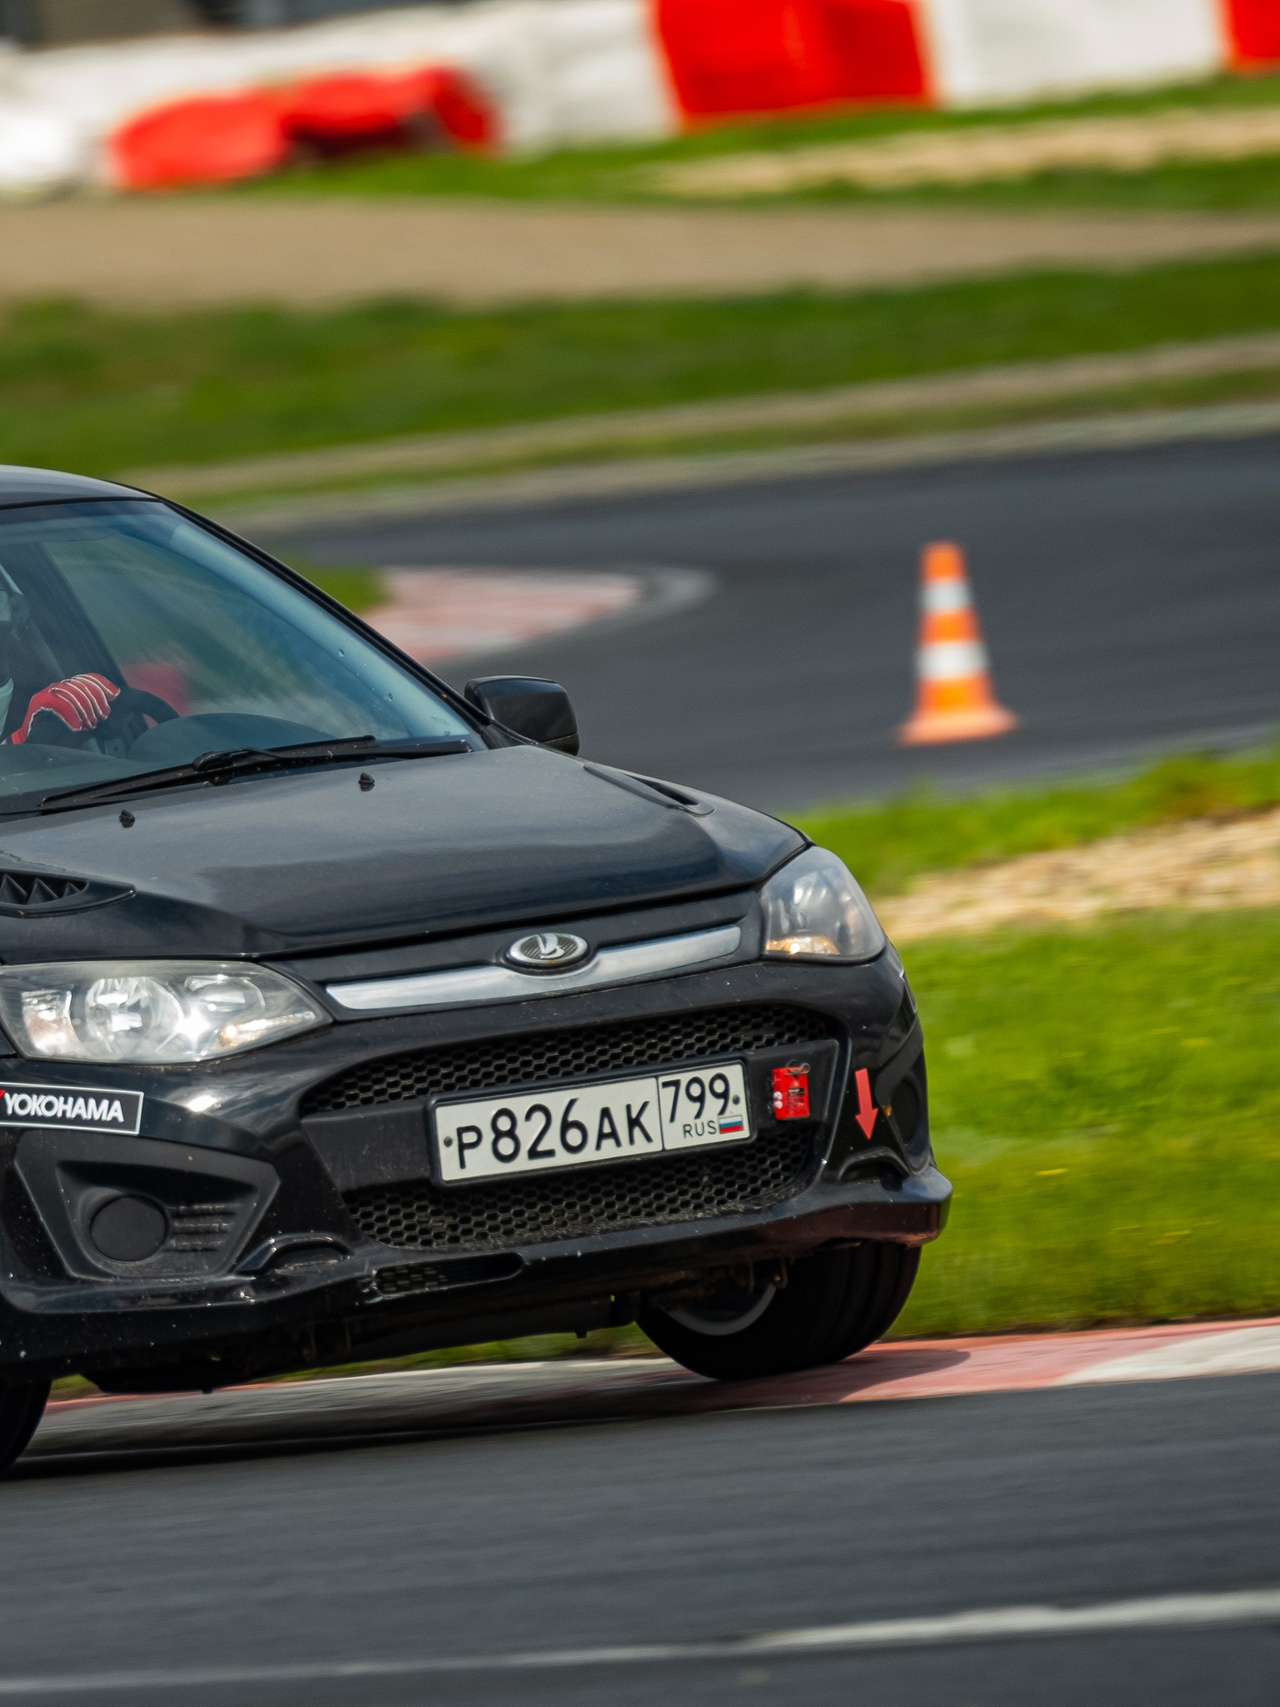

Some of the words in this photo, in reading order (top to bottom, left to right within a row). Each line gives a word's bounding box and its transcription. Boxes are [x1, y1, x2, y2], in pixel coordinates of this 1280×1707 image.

[4, 1093, 124, 1123] YOKOHAMA
[661, 1073, 731, 1124] 799
[683, 1122, 718, 1139] RUS
